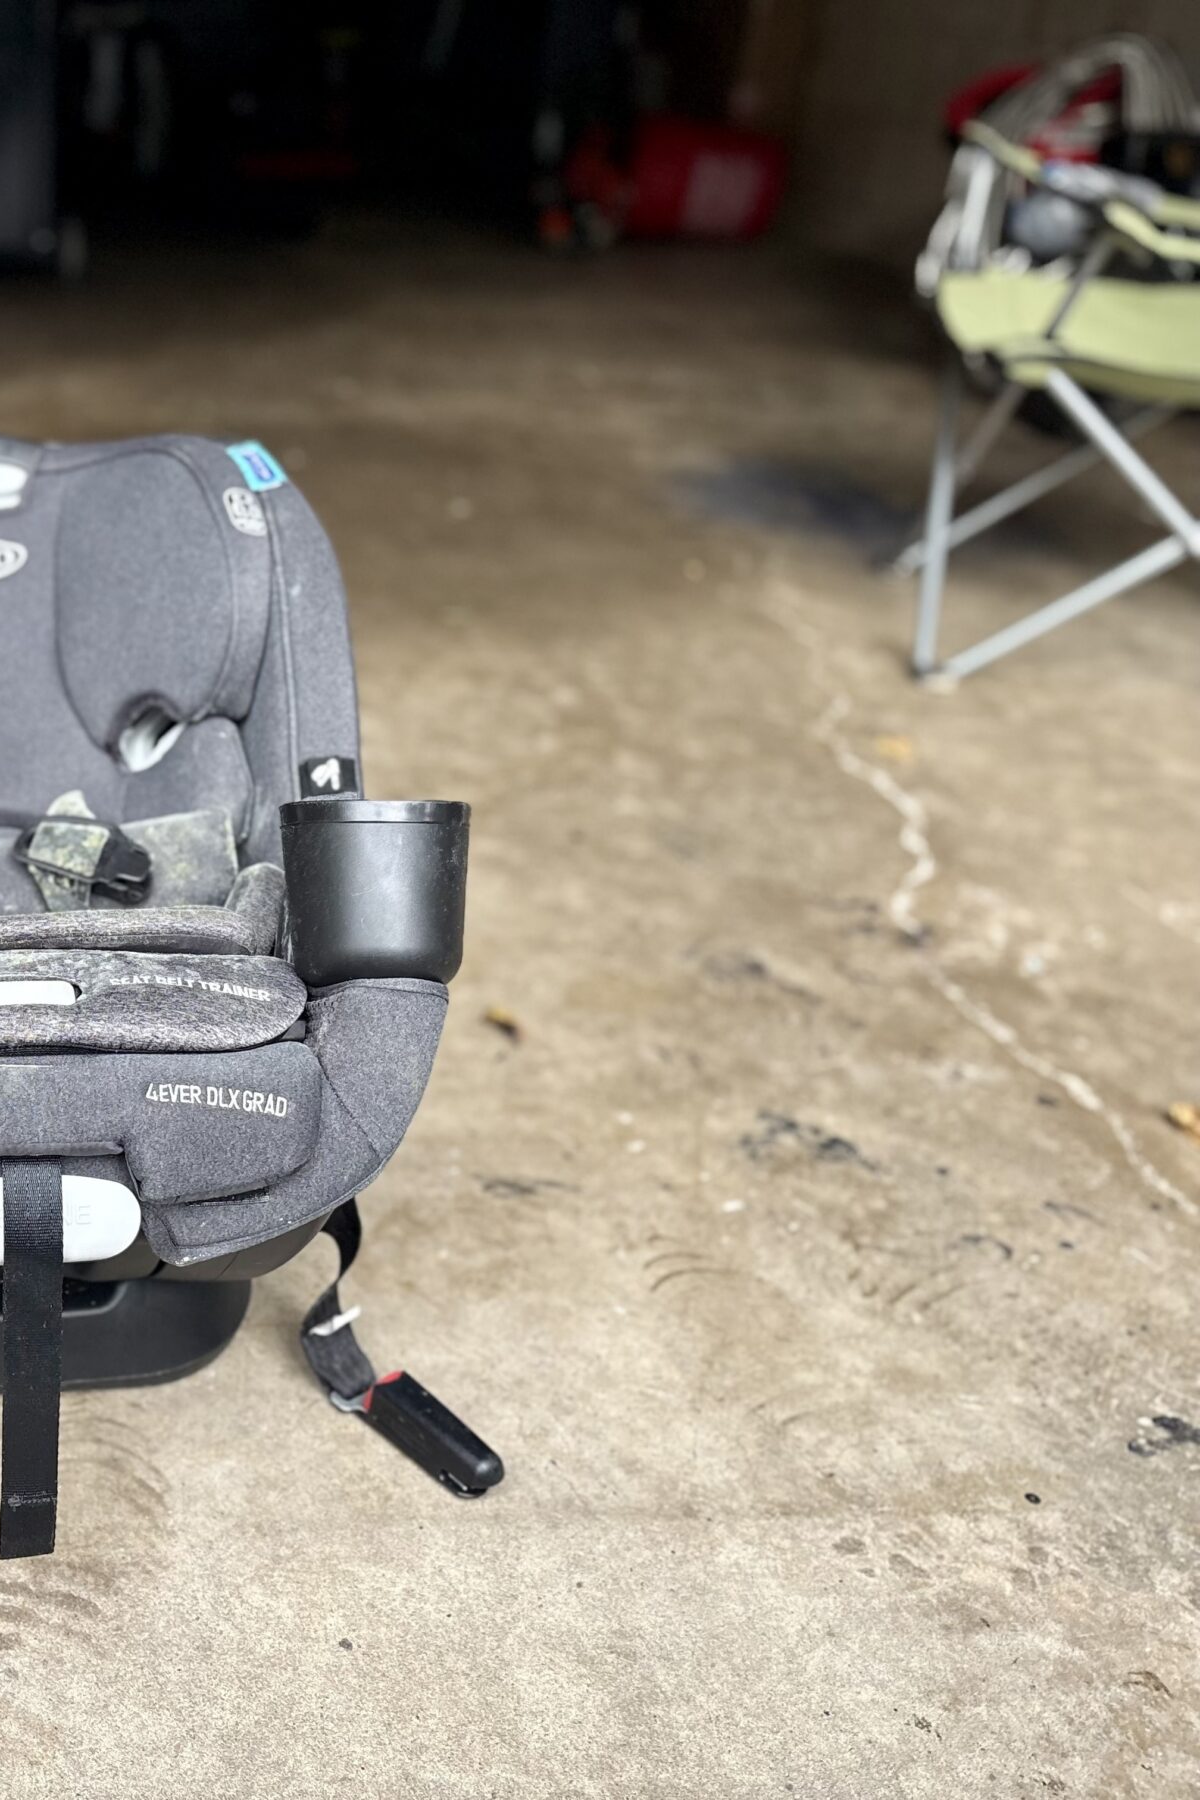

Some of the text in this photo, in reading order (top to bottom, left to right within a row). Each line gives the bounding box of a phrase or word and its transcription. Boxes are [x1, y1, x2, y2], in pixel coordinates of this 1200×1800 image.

[154, 975, 195, 988] BELT
[198, 980, 271, 1001] TRAINER
[145, 1082, 288, 1117] 4EVER DLX GRAD
